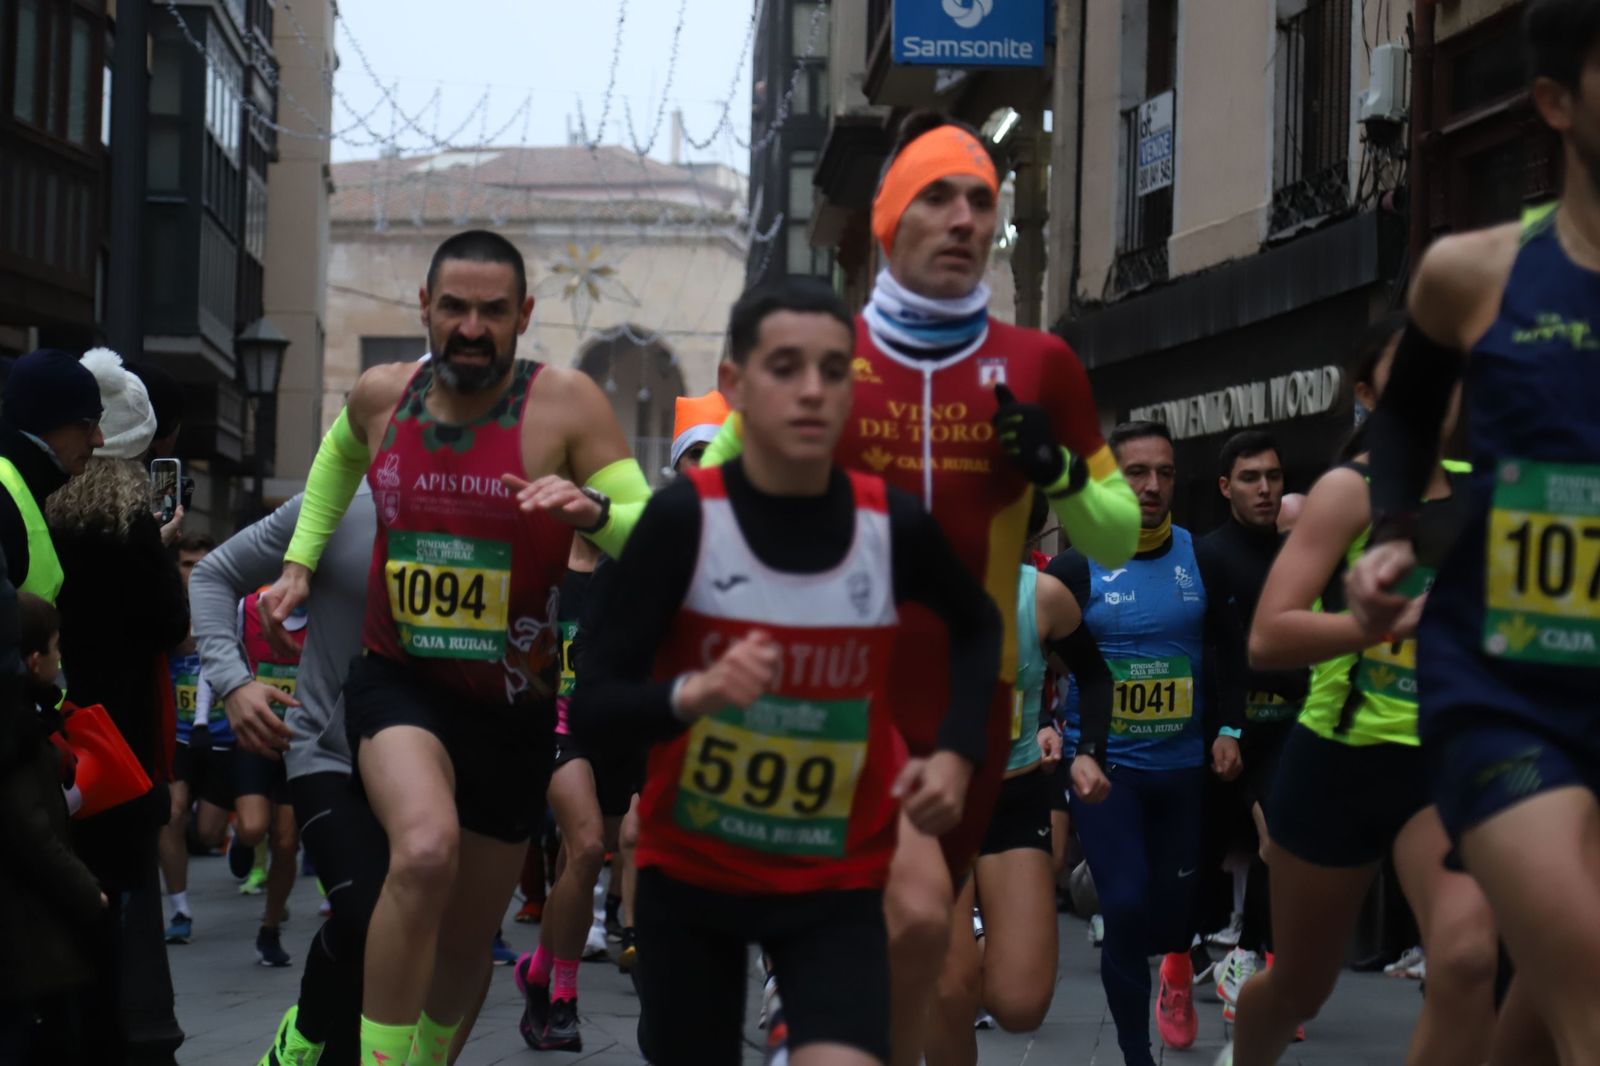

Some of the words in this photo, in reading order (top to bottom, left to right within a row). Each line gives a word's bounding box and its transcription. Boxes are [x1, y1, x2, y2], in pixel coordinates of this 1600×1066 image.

[902, 36, 1033, 59] Samsonite
[1270, 365, 1340, 421] WORLD
[888, 401, 967, 421] VINO
[860, 419, 899, 439] DE
[907, 423, 993, 442] TORO
[413, 473, 457, 492] APIS
[393, 566, 486, 619] 1094
[412, 635, 446, 649] CAJA
[448, 636, 498, 651] RURAL
[1116, 681, 1176, 713] 1041
[1129, 725, 1153, 733] CAJA
[693, 736, 836, 816] 599
[719, 816, 767, 841] CAJA
[772, 826, 837, 846] RURAL
